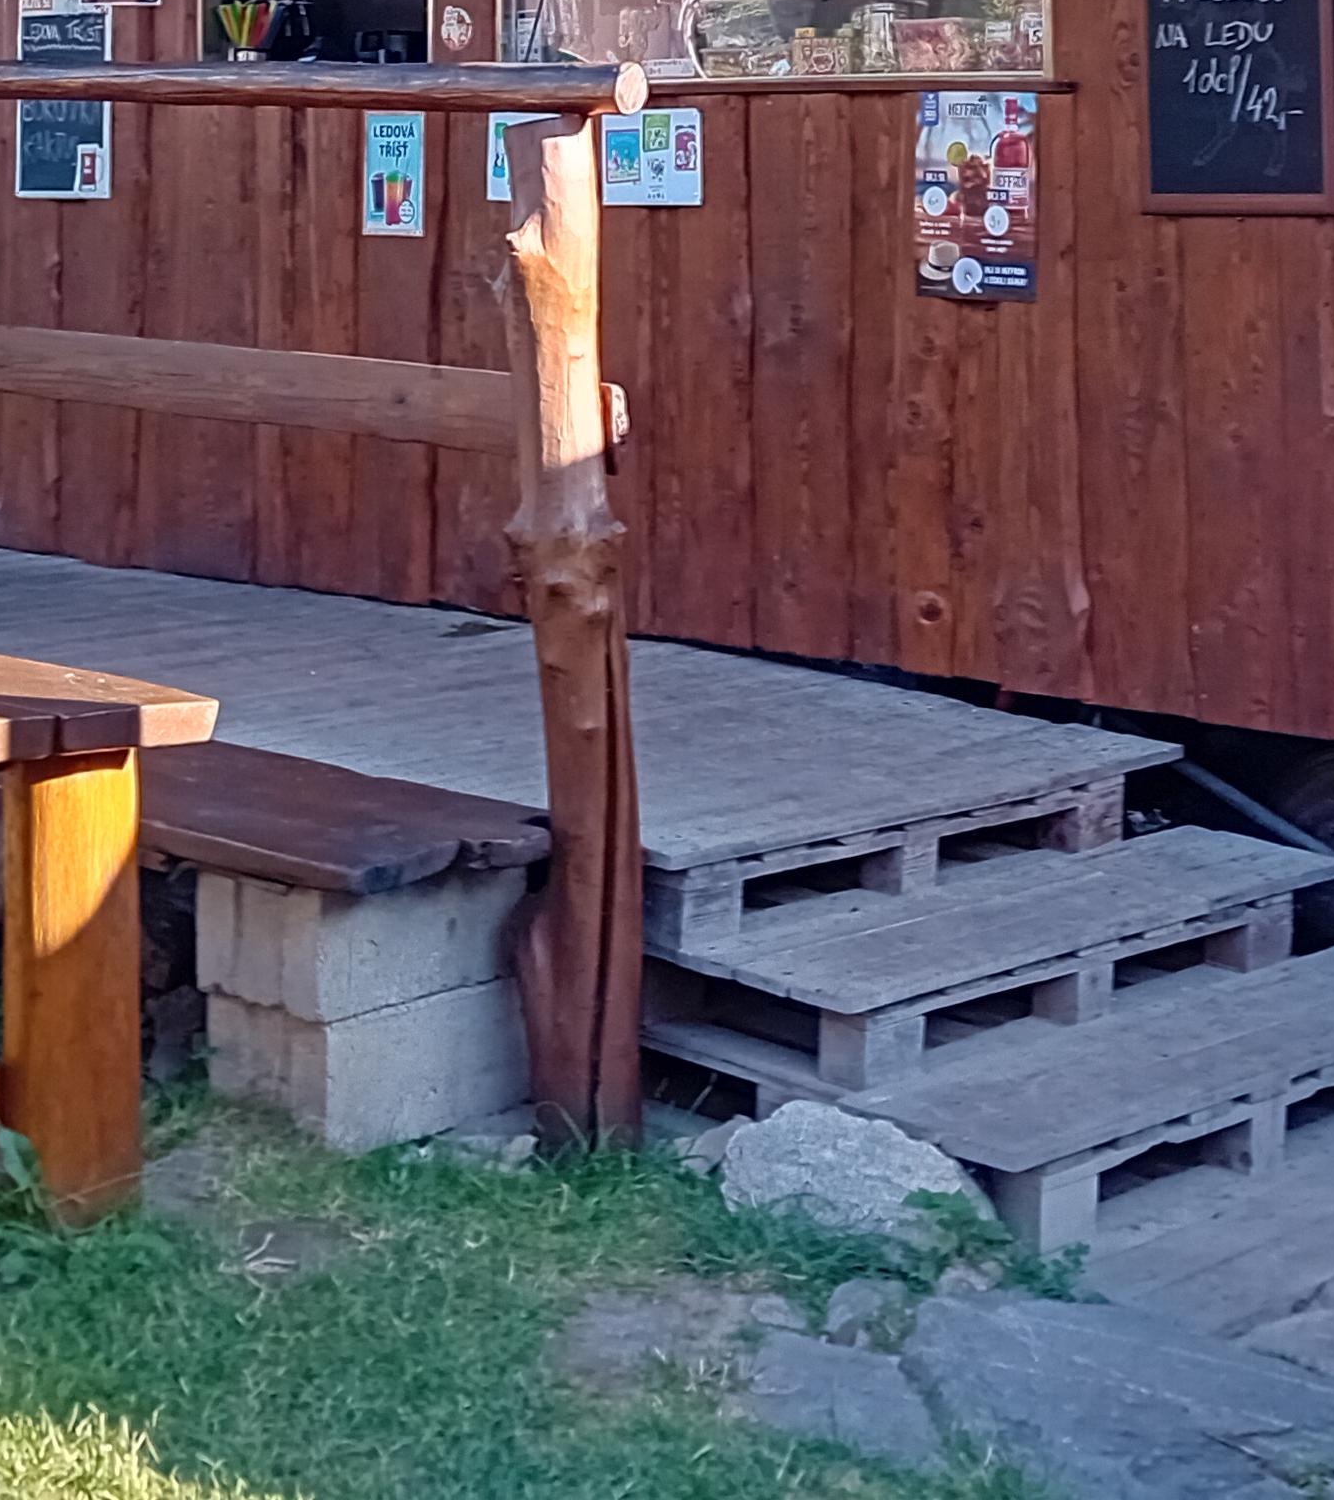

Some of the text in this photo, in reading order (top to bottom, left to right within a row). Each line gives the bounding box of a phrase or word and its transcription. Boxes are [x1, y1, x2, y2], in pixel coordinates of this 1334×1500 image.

[1155, 21, 1274, 51] NA LEDU
[373, 122, 415, 138] LEDOVÁ
